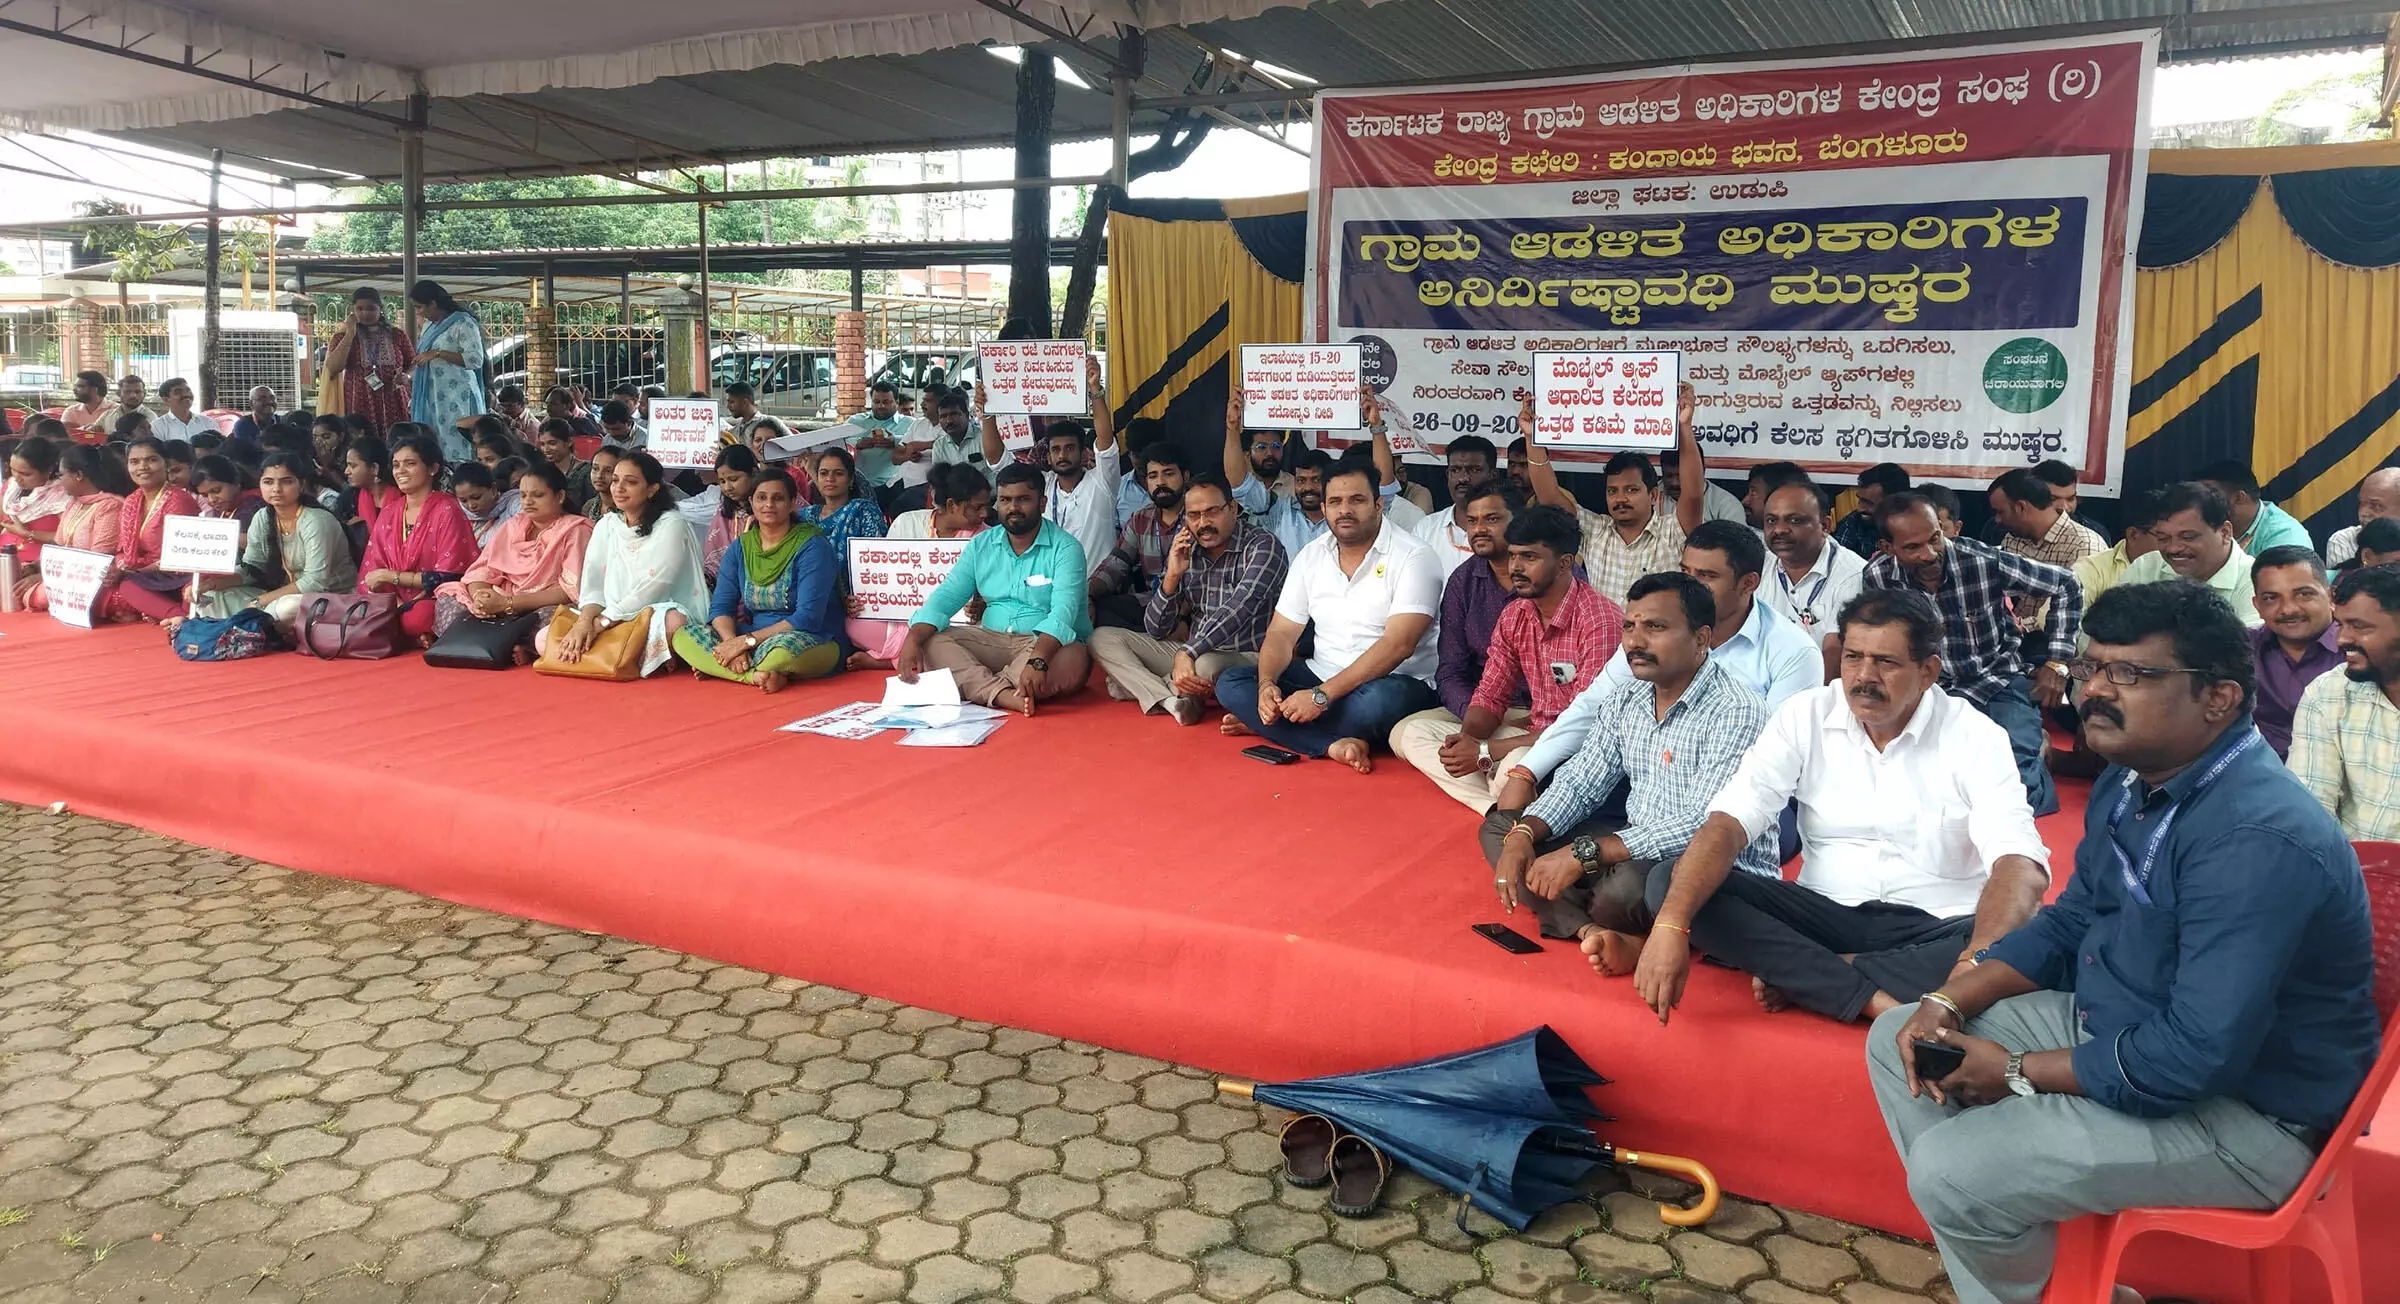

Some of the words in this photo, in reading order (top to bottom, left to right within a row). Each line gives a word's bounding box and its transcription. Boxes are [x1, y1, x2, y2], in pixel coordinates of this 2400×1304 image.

[1346, 106, 1445, 138] ಕರ್ನಾಟಕ
[1456, 108, 1511, 145] ರಾಜ್ಯ
[1523, 99, 1585, 140] ಗ್ರಾಮ
[1598, 90, 1681, 124] ಆಡಳಿತ
[1695, 81, 1843, 125] ಅಧಿಕಾರಿಗಳ
[1858, 72, 1942, 118] ಕೇಂದ್ರ
[1957, 67, 2030, 107] ಸಂಘ
[2047, 59, 2102, 104] (ರಿ)
[1434, 151, 1499, 185] ಕೇಂದ್ರ
[1510, 148, 1580, 179] ಕಛೇರಿ
[1608, 141, 1717, 172] ಕಂದಾಯ
[1731, 135, 1803, 169] ಭವನ,
[1818, 126, 1969, 161] ಬೆಂಗಳೂರು
[1571, 184, 1621, 211] ಜಿಲ್ಲಾ
[1632, 181, 1696, 206] ಘಟಕ:
[1709, 177, 1789, 201] ಉಡುಪಿ
[1360, 226, 1481, 273] ಗ್ರಾಮ
[1510, 219, 1686, 260] ಆಡಳಿತ
[1718, 204, 2062, 260] ಅಧಿಕಾರಿಗಳ
[1418, 268, 1736, 326] ಅನಿರ್ದಿಷ್ಟಾವಧಿ
[1769, 261, 1973, 323] ಮುಷ್ಕರ
[1021, 342, 1039, 357] ರಜೆ
[1043, 343, 1084, 360] ದಿನಗಳಲ್ಲಿ
[1309, 351, 1341, 365] 15-20
[1423, 334, 1460, 354] ಗ್ರಾಮ
[1466, 335, 1516, 350] ಆಡಳಿತ
[1737, 335, 1854, 363] ಸೌಲಭ್ಯಗಳನ್ನು
[2003, 352, 2048, 365] ಸಂಘಟನೆ
[994, 359, 1018, 373] ಕೆಲಸ
[1023, 360, 1074, 373] ನಿರ್ವಹಿಸುವ
[1451, 359, 1491, 376] ಸೇವಾ
[1497, 360, 1533, 377] ಸೌಲ
[1689, 363, 1730, 386] ಮತ್ತು
[1738, 363, 1812, 389] ಮೊಬೈಲ್
[1552, 356, 1613, 388] ಮೊಬೈಲ್
[992, 376, 1017, 394] ಒತ್ತಡ
[1244, 388, 1267, 405] ಗ್ರಾಮ
[1547, 384, 1604, 408] ಆಧಾರಿತ
[1612, 383, 1664, 407] ಕೆಲಸದ
[655, 404, 686, 420] ಅಂತರ
[1314, 406, 1334, 419] ನೀಡಿ
[1413, 384, 1506, 401] ನಿರಂತರವಾಗಿ
[1792, 392, 1881, 419] ಒತ್ತಡವನ್ನು
[1890, 394, 1962, 418] ನಿಲ್ಲಿಸಲು
[660, 425, 706, 443] ವರ್ಗಾವಣೆ
[1412, 412, 1522, 435] 26-09-20
[1770, 421, 1825, 447] ಕೆಲಸ
[1836, 424, 1969, 460] ಸ್ಥಗಿತಗೊಳಿಸಿ
[1982, 426, 2067, 464] ಮುಷ್ಕರ.
[1537, 412, 1574, 440] ಒತ್ತಡ
[1582, 412, 1626, 435] ಕಡಿಮೆ
[1634, 415, 1673, 436] ಮಾಡಿ
[858, 547, 922, 569] ಸಕಾಲದಲ್ಲಿ
[860, 568, 889, 585] ಕೇಳಿ
